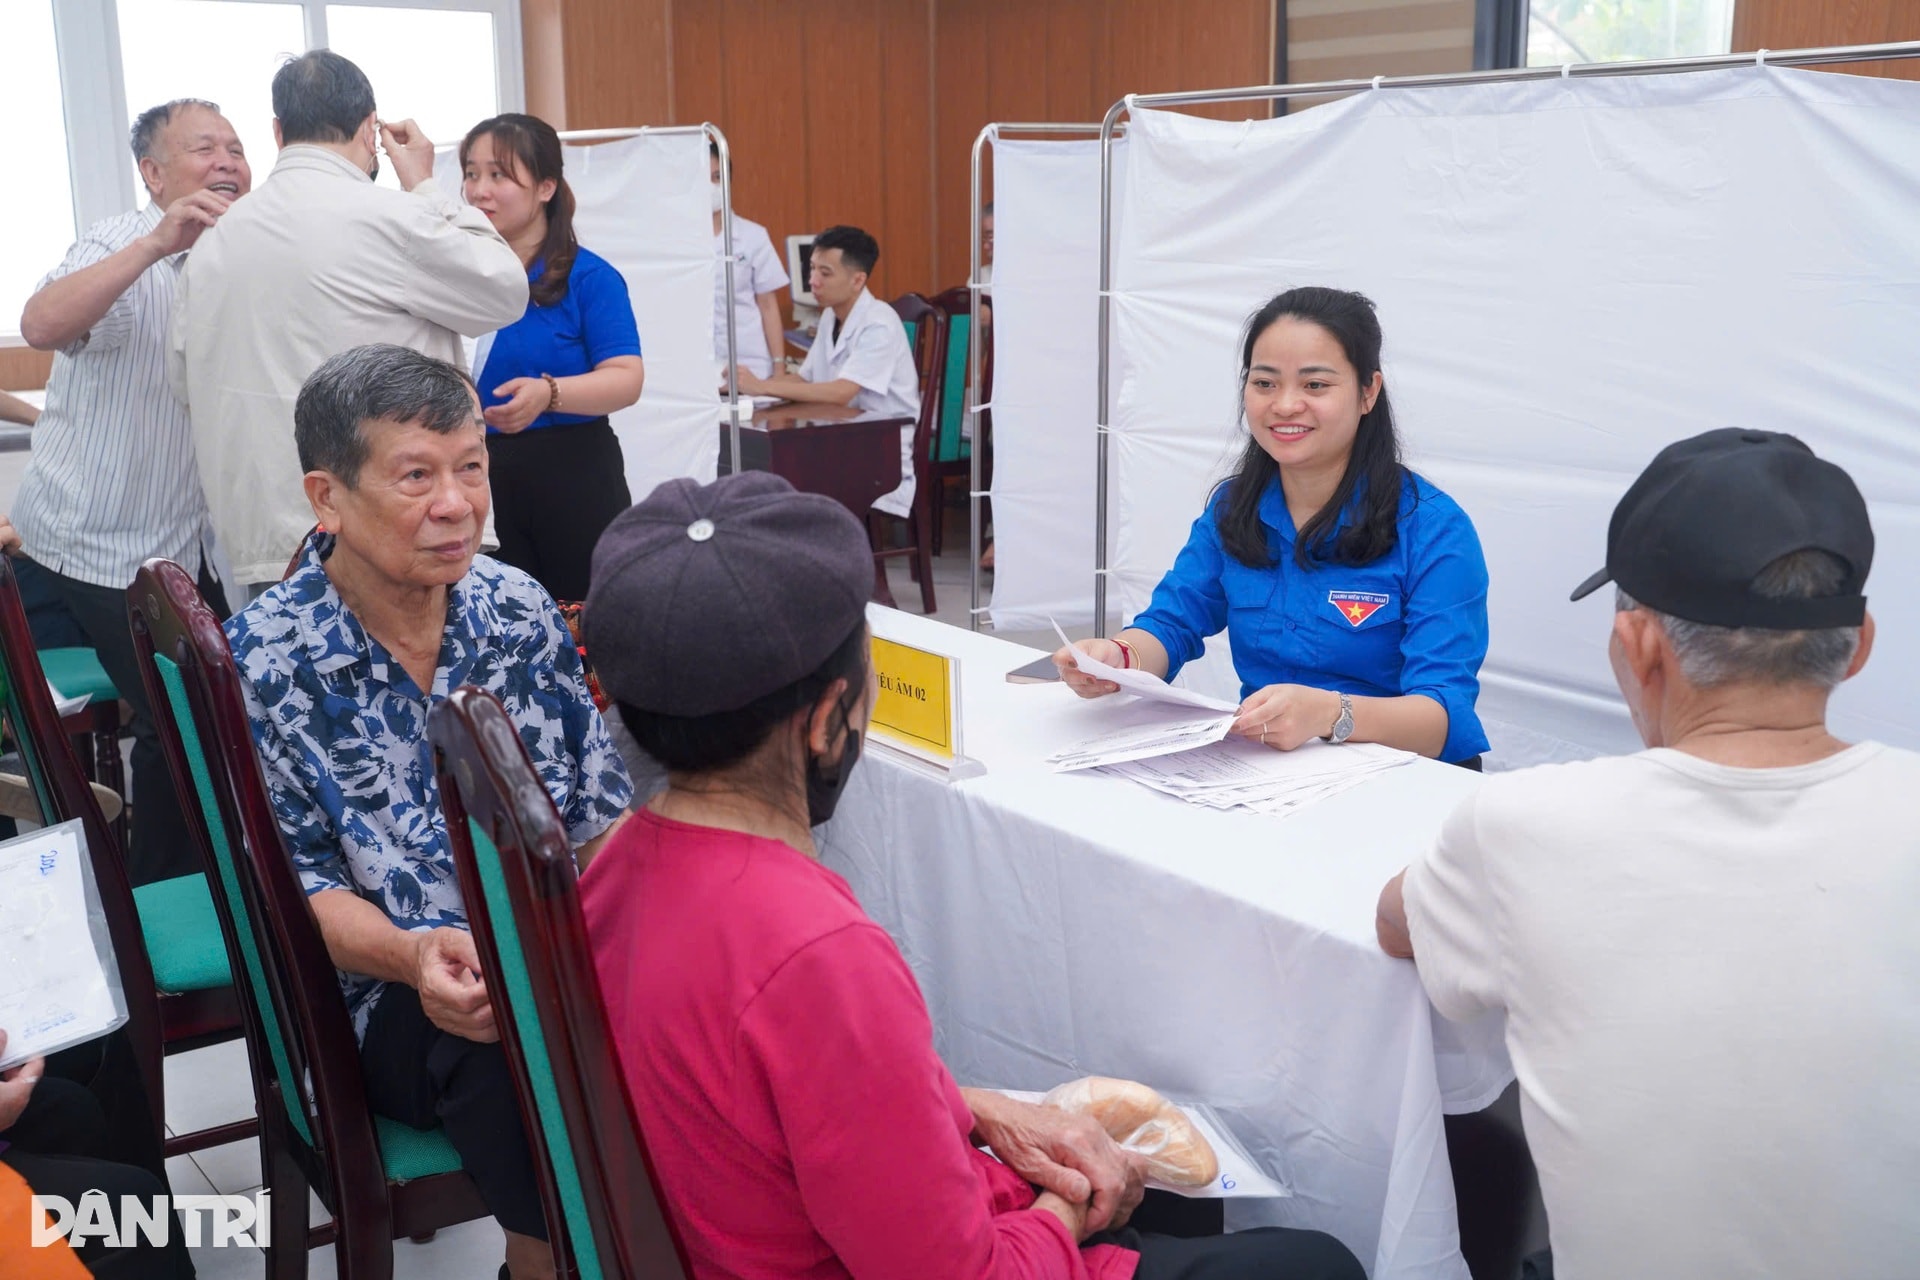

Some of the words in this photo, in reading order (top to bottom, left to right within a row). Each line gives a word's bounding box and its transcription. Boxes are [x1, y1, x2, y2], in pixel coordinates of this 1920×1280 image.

[1360, 594, 1374, 603] VIỆT
[895, 677, 913, 697] ÂM
[915, 686, 926, 702] 02
